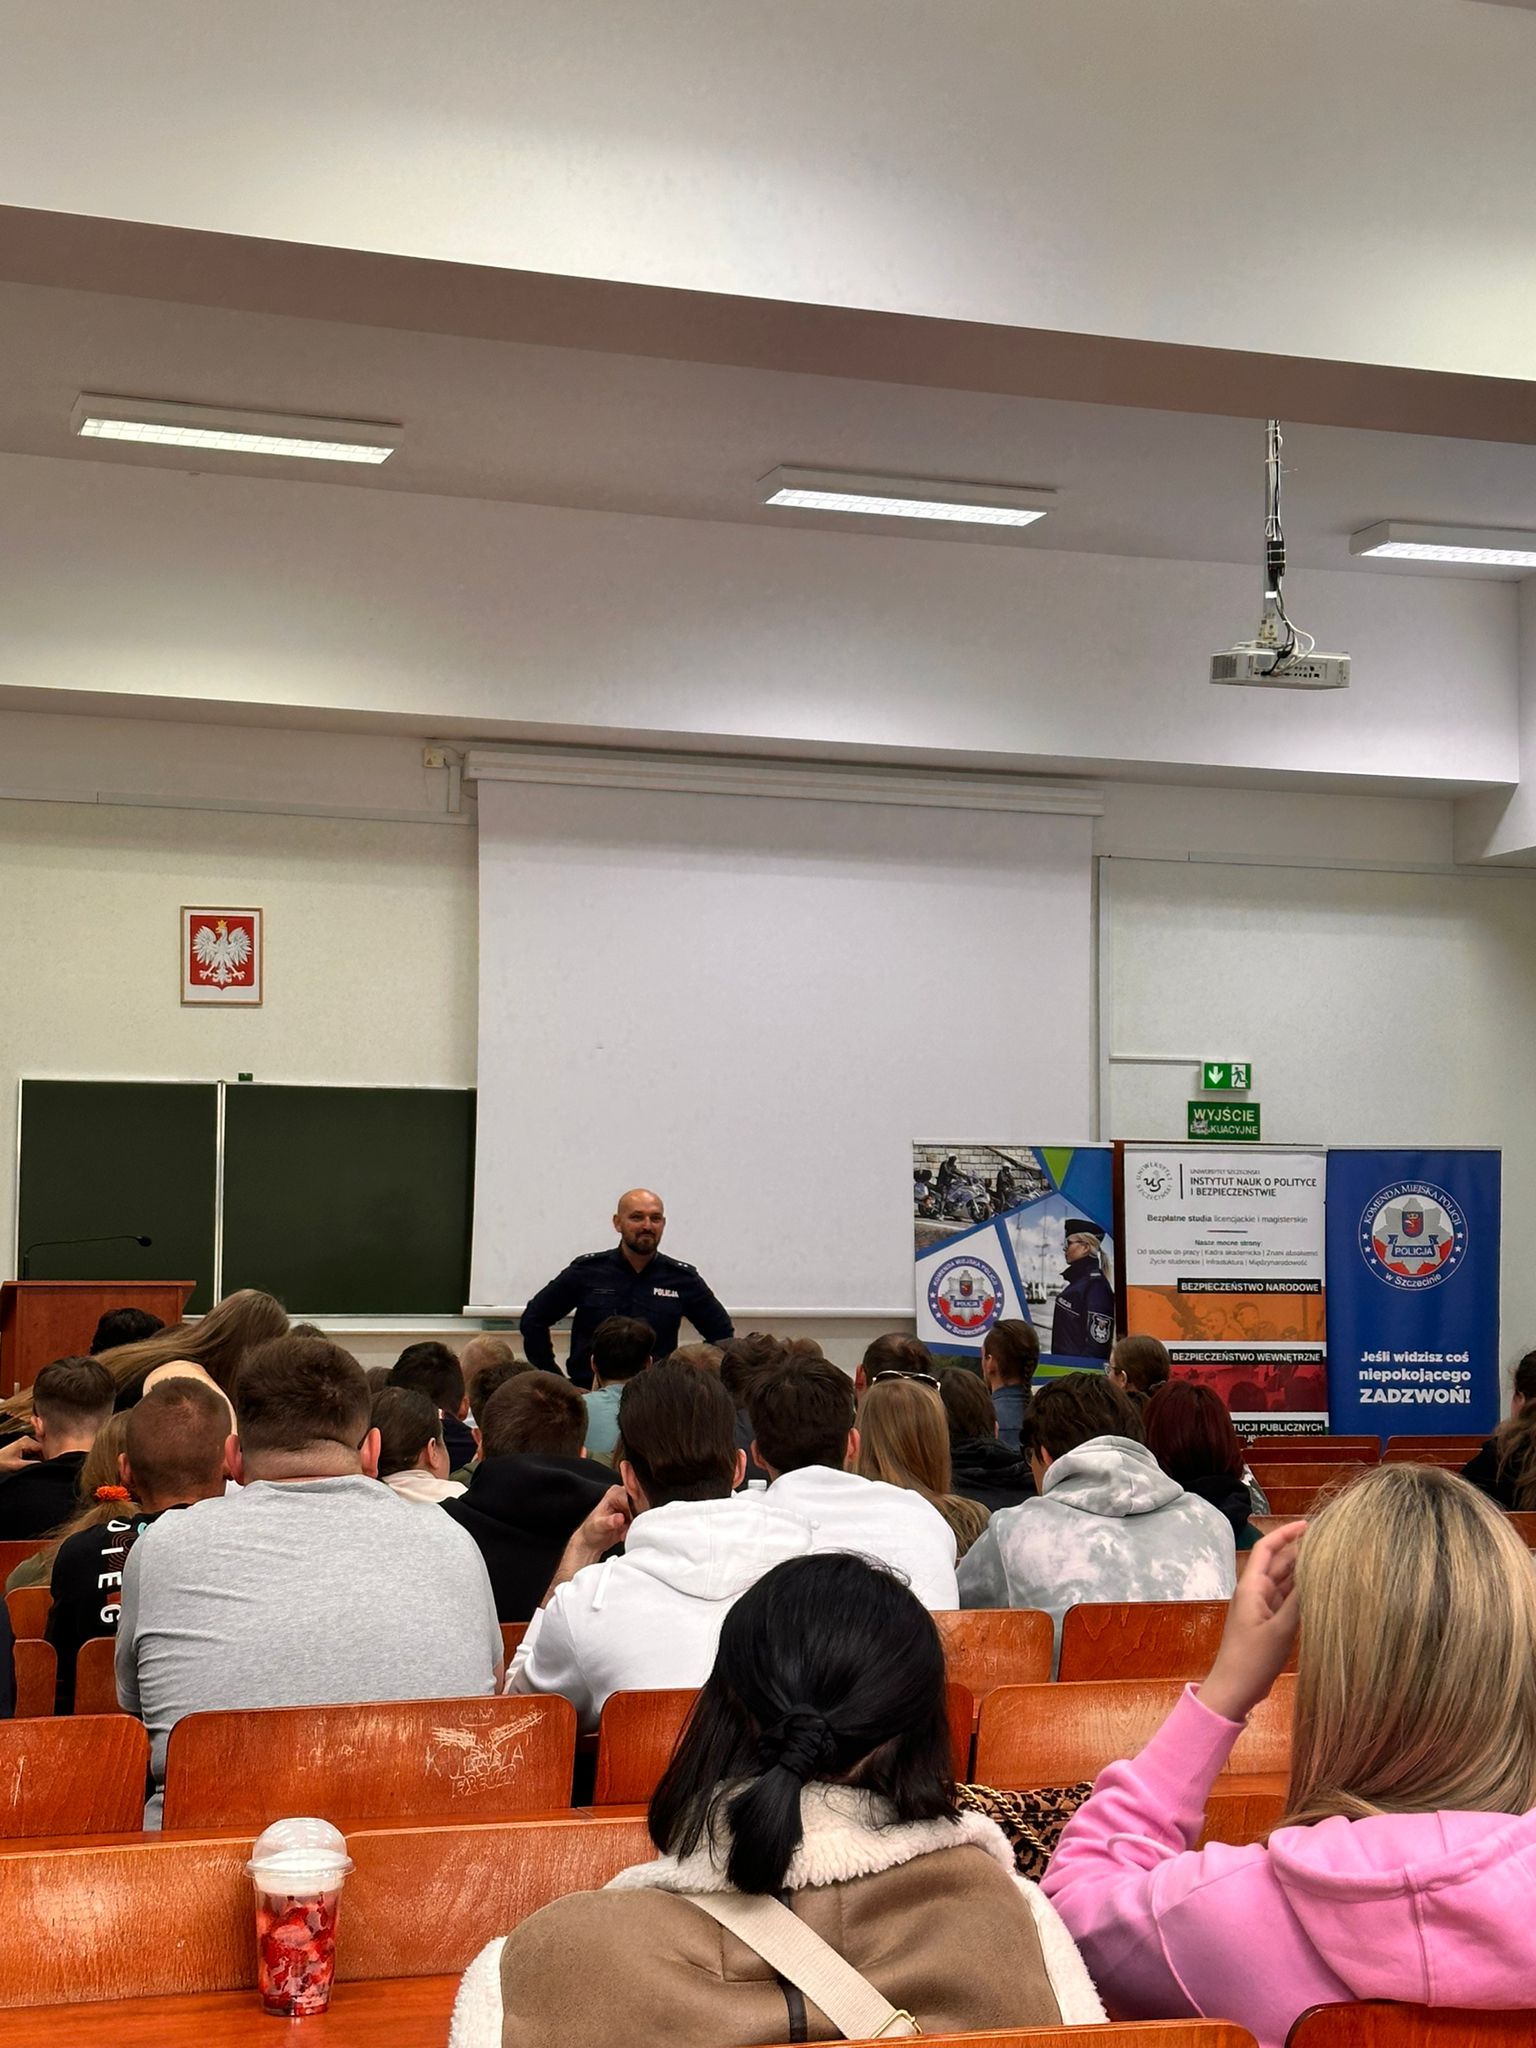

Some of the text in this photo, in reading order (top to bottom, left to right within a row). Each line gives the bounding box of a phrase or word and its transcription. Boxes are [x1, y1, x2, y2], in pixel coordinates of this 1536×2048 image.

[1193, 1106, 1255, 1122] WYJŚCIE
[1190, 1124, 1259, 1135] EKUACYJNE
[1190, 1177, 1317, 1188] INSTYTUT NAUK O POLITYCE
[1196, 1187, 1276, 1197] BEZPIECZEŃSTWIE
[1363, 1184, 1462, 1226] KOMENDA MIEJSKA POLICJI
[1147, 1214, 1186, 1223] Bezpłatne
[1188, 1214, 1212, 1223] studia
[1214, 1215, 1256, 1224] licencjackie
[1261, 1216, 1308, 1225] magisterskie
[1394, 1247, 1433, 1256] POLICJA
[1385, 1272, 1442, 1287] w Szczecinie
[653, 1287, 679, 1298] POLICJA
[1181, 1281, 1319, 1293] BEZPIECZEŃSTWO NARODOWE
[1172, 1350, 1321, 1364] BEZPIECZEŃSTWO WEWNĘTRZNE
[1360, 1350, 1470, 1363] Jeśli widzisz coś
[1359, 1368, 1472, 1383] niepokojącego
[1359, 1385, 1471, 1404] ZADZWOŃ!
[1260, 1423, 1323, 1432] PUBLICZNYCH
